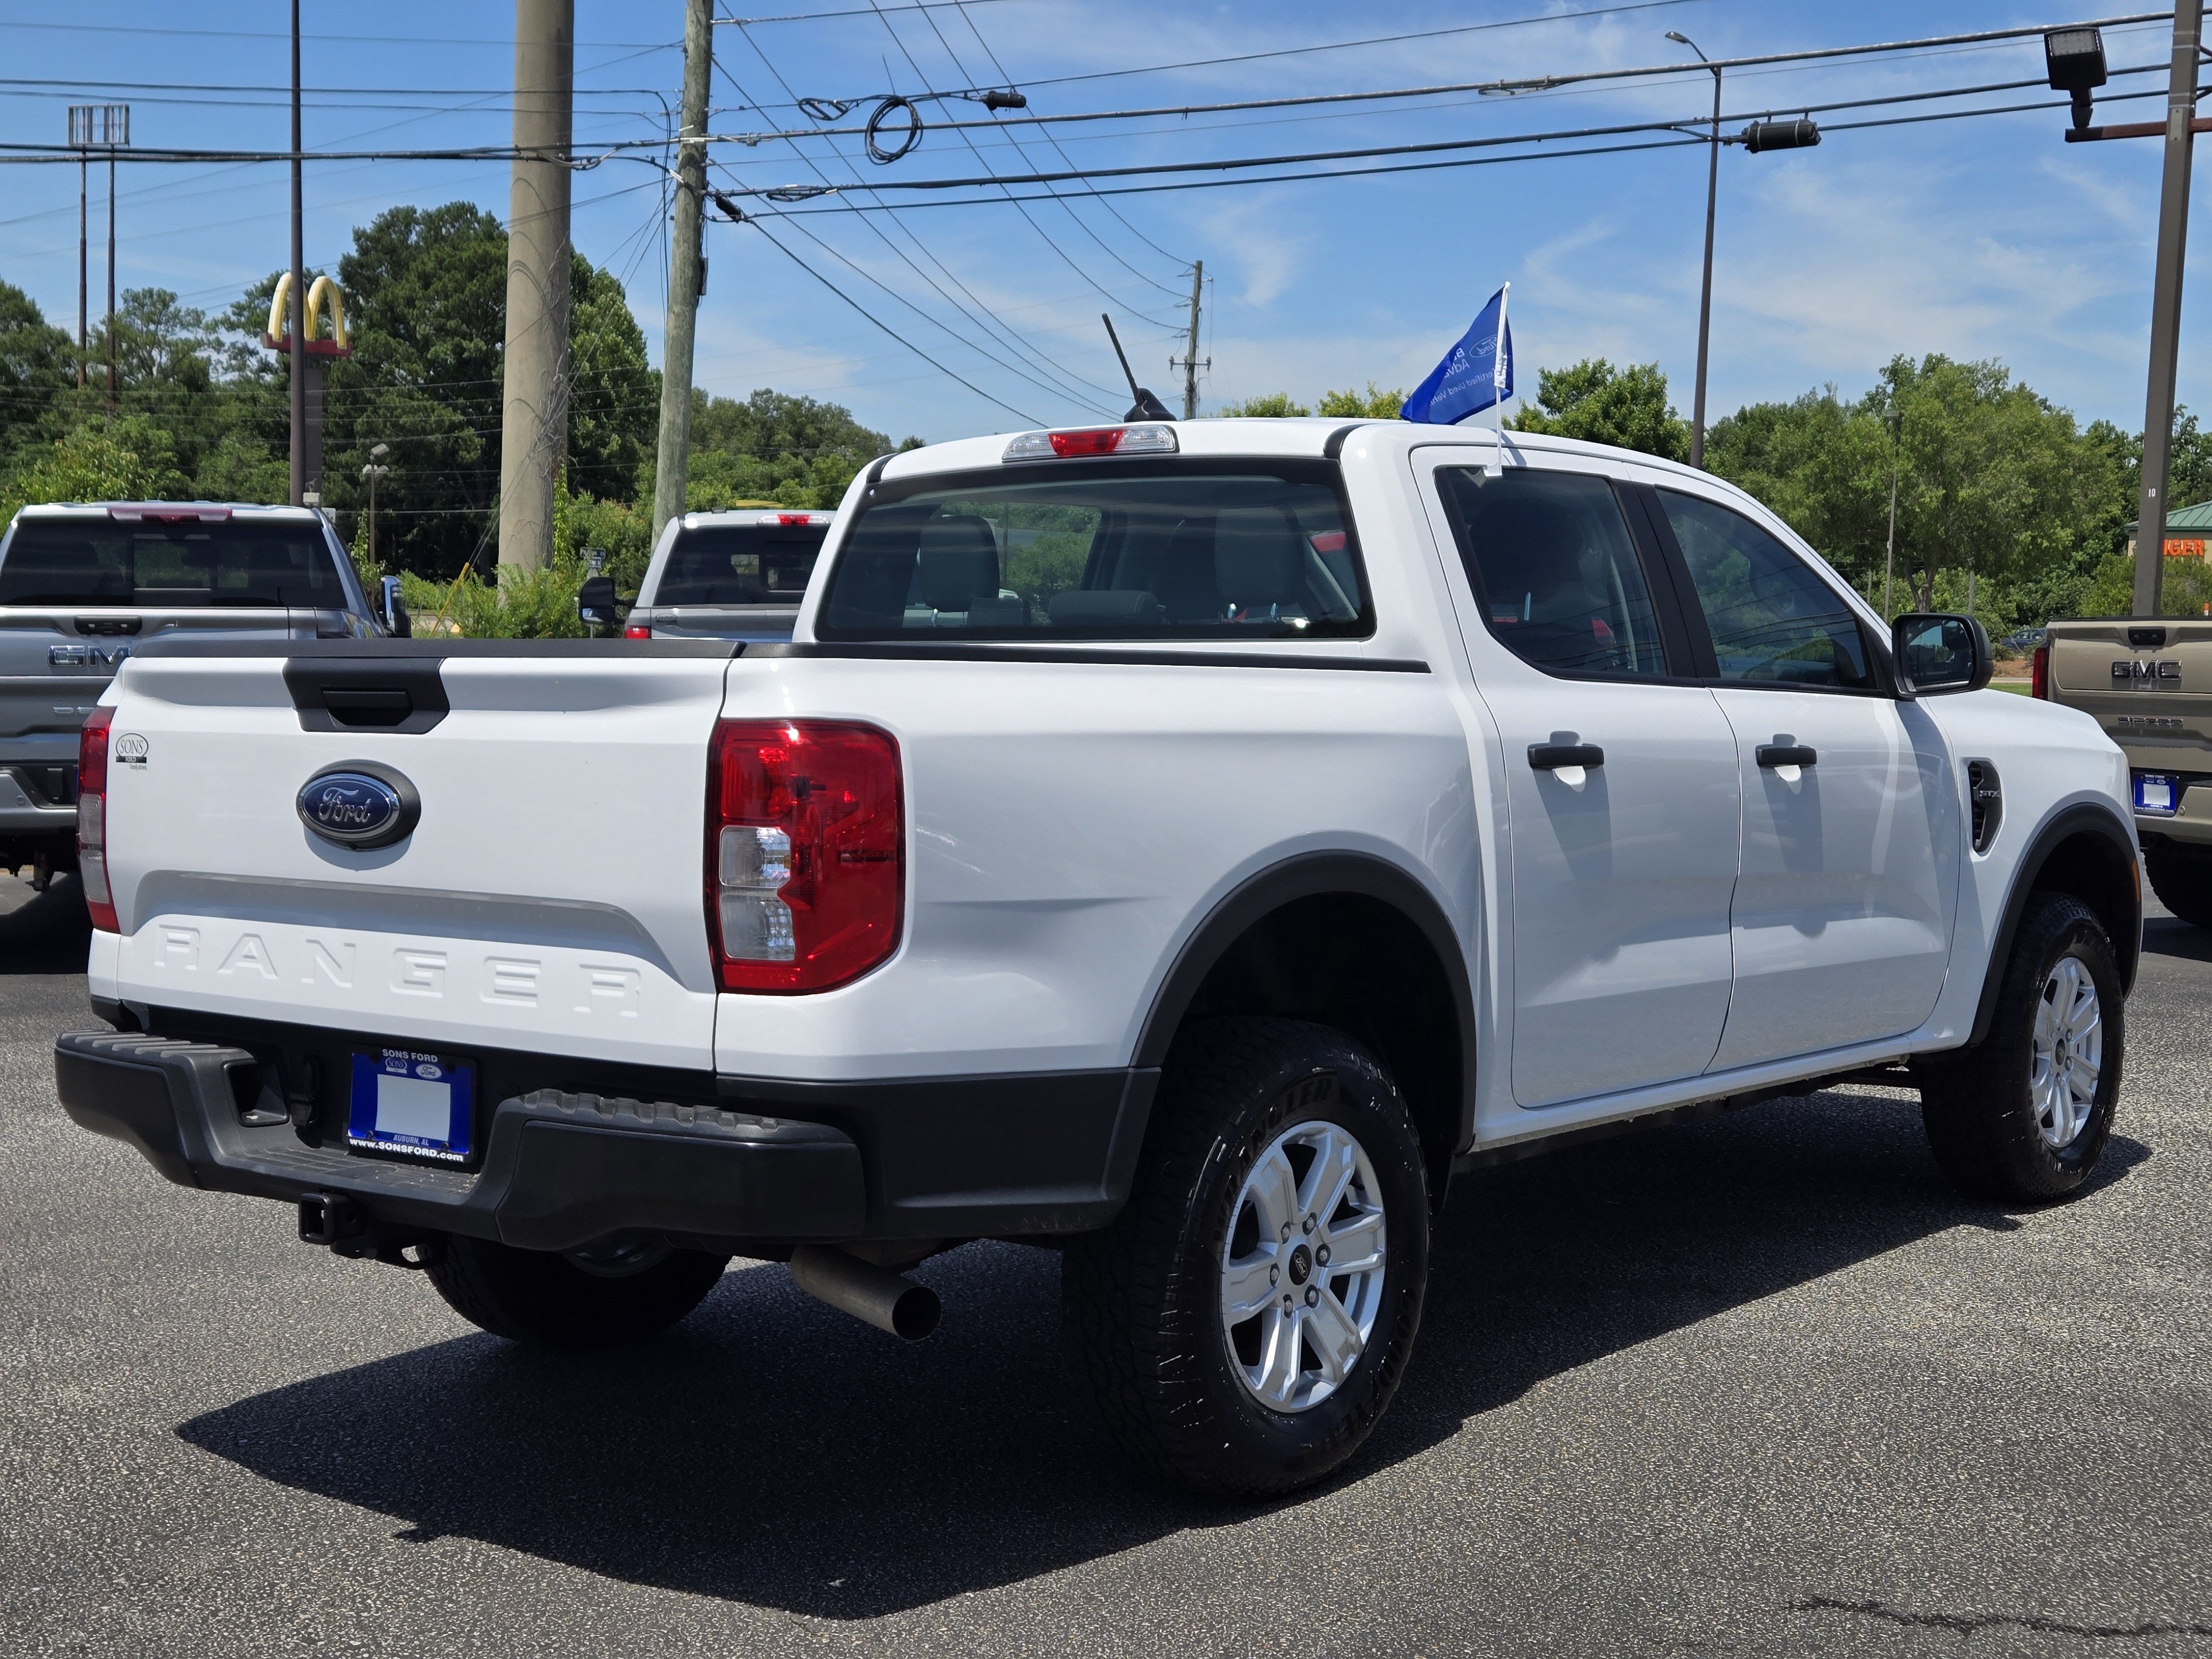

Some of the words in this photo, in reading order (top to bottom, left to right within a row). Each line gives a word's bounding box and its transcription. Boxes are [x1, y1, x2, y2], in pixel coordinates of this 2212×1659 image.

[2148, 488, 2156, 498] 10
[2163, 539, 2205, 556] IGER
[47, 645, 131, 667] GM
[2111, 659, 2182, 680] GMC
[119, 739, 143, 754] SONS
[317, 787, 371, 823] Ford
[153, 924, 642, 1018] RANGER
[382, 1048, 409, 1059] SONS
[411, 1052, 438, 1062] FORD
[388, 1058, 404, 1068] SONS
[420, 1065, 436, 1077] Ford
[393, 1134, 420, 1145] AUBURN,
[349, 1138, 463, 1162] www.SONSFORD.com
[1296, 1257, 1306, 1274] Ford
